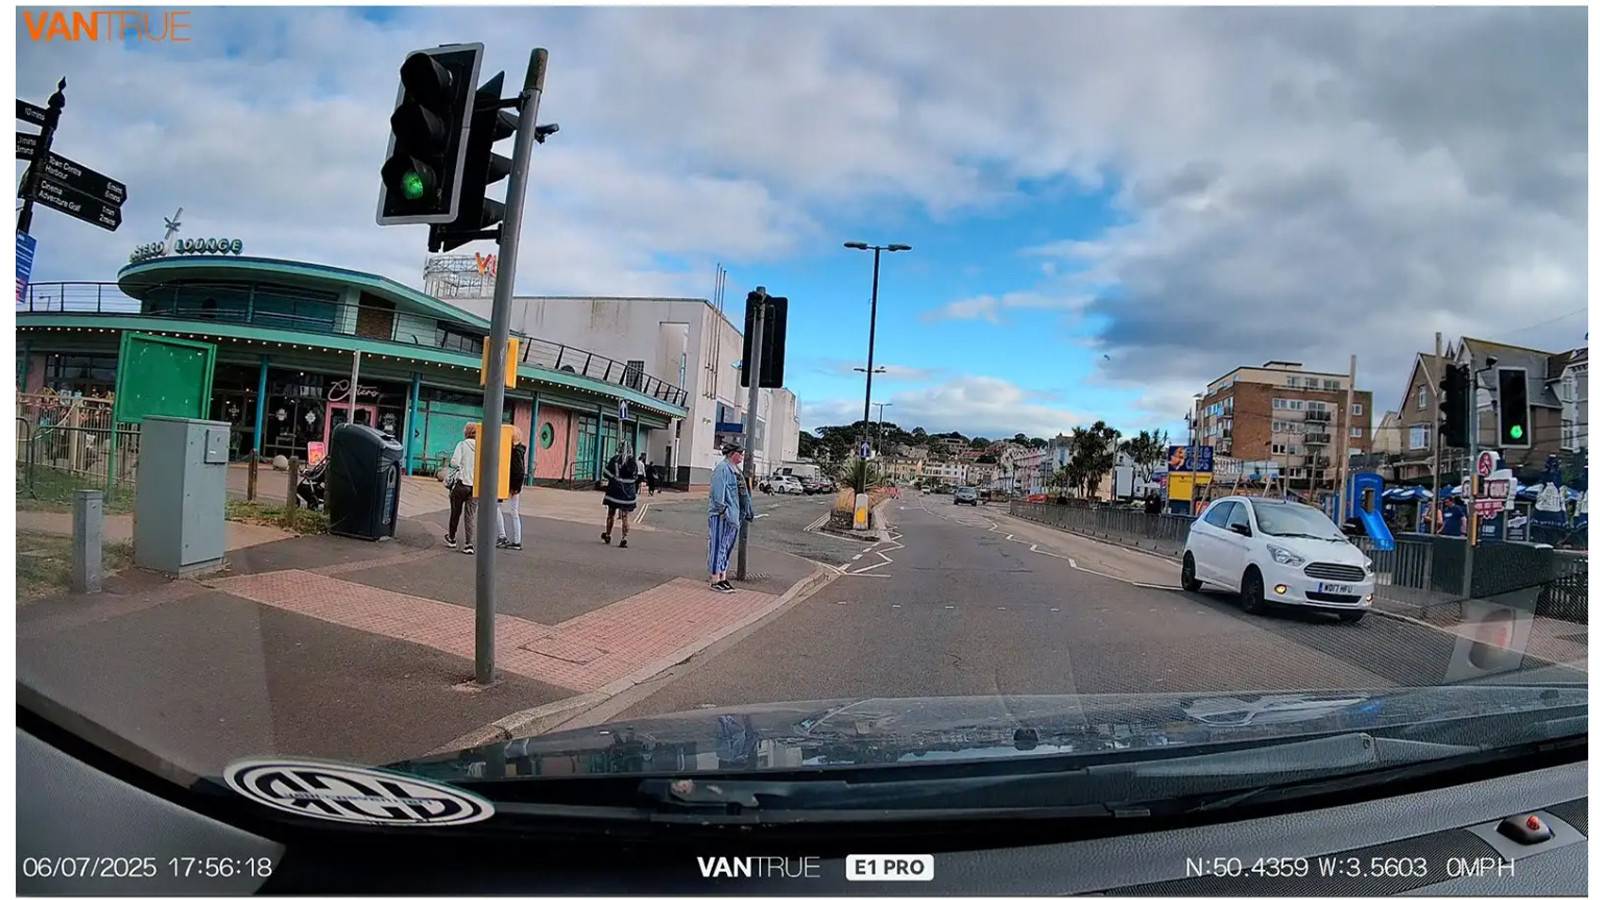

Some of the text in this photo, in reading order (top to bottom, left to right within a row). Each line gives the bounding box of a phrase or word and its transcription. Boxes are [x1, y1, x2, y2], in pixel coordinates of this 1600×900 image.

[45, 165, 69, 180] Harbour
[63, 162, 82, 177] Centre
[41, 180, 63, 195] Cinema
[38, 190, 68, 208] Adventure
[68, 201, 81, 212] Golf
[174, 239, 242, 253] LOUNGE
